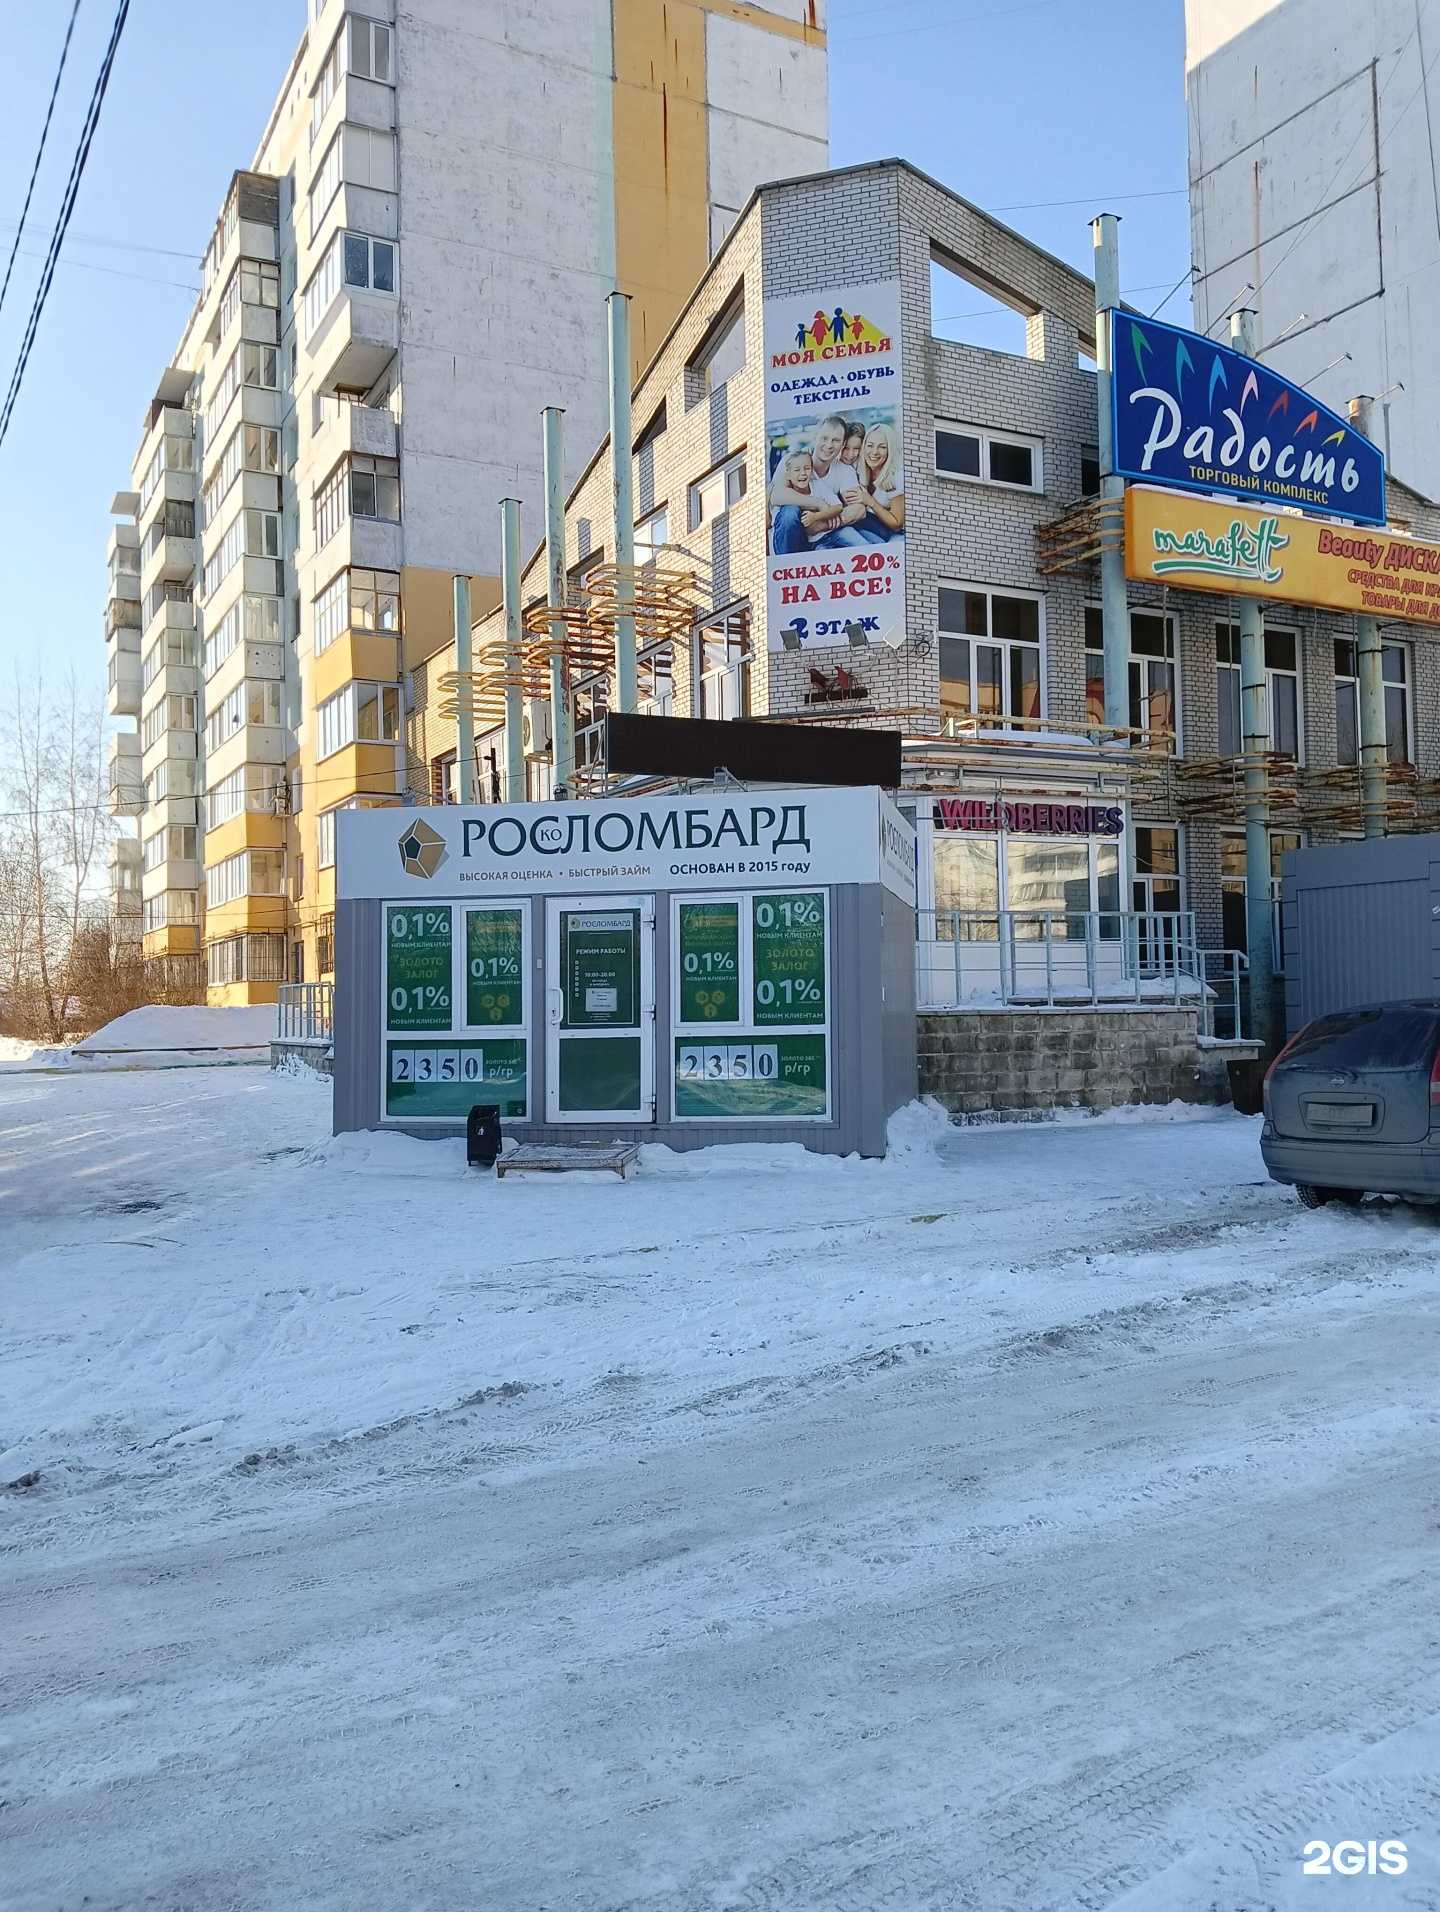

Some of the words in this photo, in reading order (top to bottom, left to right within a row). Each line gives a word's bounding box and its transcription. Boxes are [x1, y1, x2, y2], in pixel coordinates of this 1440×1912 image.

[771, 350, 815, 368] МОЯ
[822, 337, 892, 360] СЕМЬЯ
[771, 374, 838, 393] ОДЕЖДА
[847, 366, 895, 382] ОБУВЬ
[794, 386, 871, 405] ТЕКСТИЛЬ
[1129, 387, 1360, 492] Радость
[1189, 465, 1260, 490] ТОРГОВЫЙ
[1264, 480, 1329, 504] КОМПЛЕКС
[1318, 528, 1384, 569] Beauty
[772, 562, 845, 581] СКИДКА
[851, 552, 900, 573] 20%
[781, 583, 821, 605] НА
[830, 576, 892, 599] ВСЕ!
[1347, 568, 1400, 590] СРЕДСТВА
[1401, 577, 1424, 595] ДЛЯ
[1361, 591, 1406, 611] ТОВАРЫ
[1406, 598, 1429, 615] ДЛЯ
[789, 617, 809, 640] 2
[939, 799, 1124, 835] WILDBERRIES
[462, 805, 812, 858] РОСЛОМБАРД
[459, 871, 508, 882] ВЫСОКАЯ
[511, 870, 553, 881] ОЦЕНКА
[569, 865, 618, 878] БЫСТРЫЙ
[621, 864, 651, 876] ЗАЙМ
[669, 862, 735, 875] ОСНОВАН
[738, 861, 746, 873] В
[749, 860, 778, 873] 2015
[781, 860, 811, 874] году
[391, 912, 450, 940] 0,1%
[756, 900, 821, 930] 0,1%
[470, 956, 519, 979] 0,1%
[684, 951, 735, 975] 0,1%
[391, 986, 450, 1014] 0,1%
[757, 979, 821, 1008] 0,1%
[396, 1057, 479, 1080] 2350
[684, 1053, 773, 1078] 2350
[785, 1062, 811, 1076] р/гр
